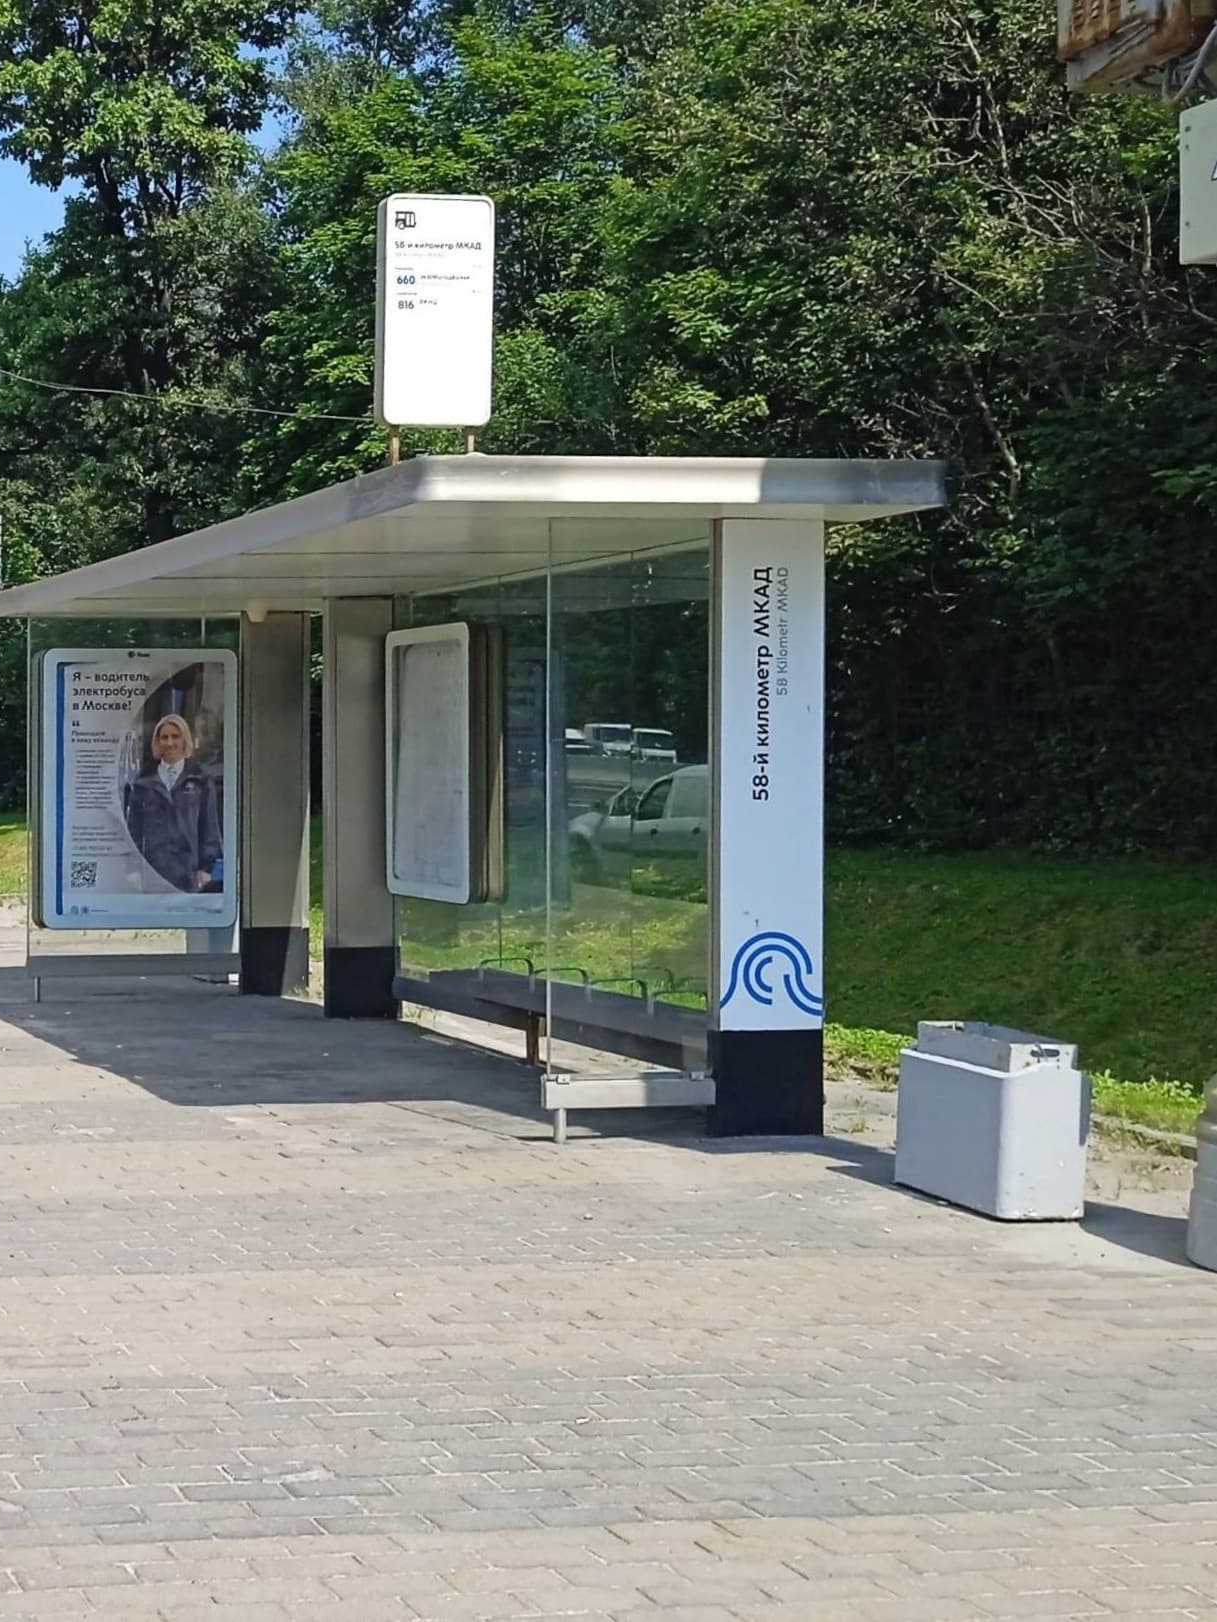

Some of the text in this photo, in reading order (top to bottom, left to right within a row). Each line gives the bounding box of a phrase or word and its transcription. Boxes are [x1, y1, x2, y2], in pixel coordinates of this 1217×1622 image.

[455, 242, 482, 250] МКАД
[396, 275, 416, 285] 660
[398, 300, 415, 309] 816
[776, 567, 789, 696] 58 Kilometr MKAD
[73, 672, 81, 681] Я
[95, 673, 150, 682] водитель
[752, 567, 773, 801] 58-й километр МКАД
[73, 685, 146, 698] электробуса
[82, 701, 132, 711] Москве!
